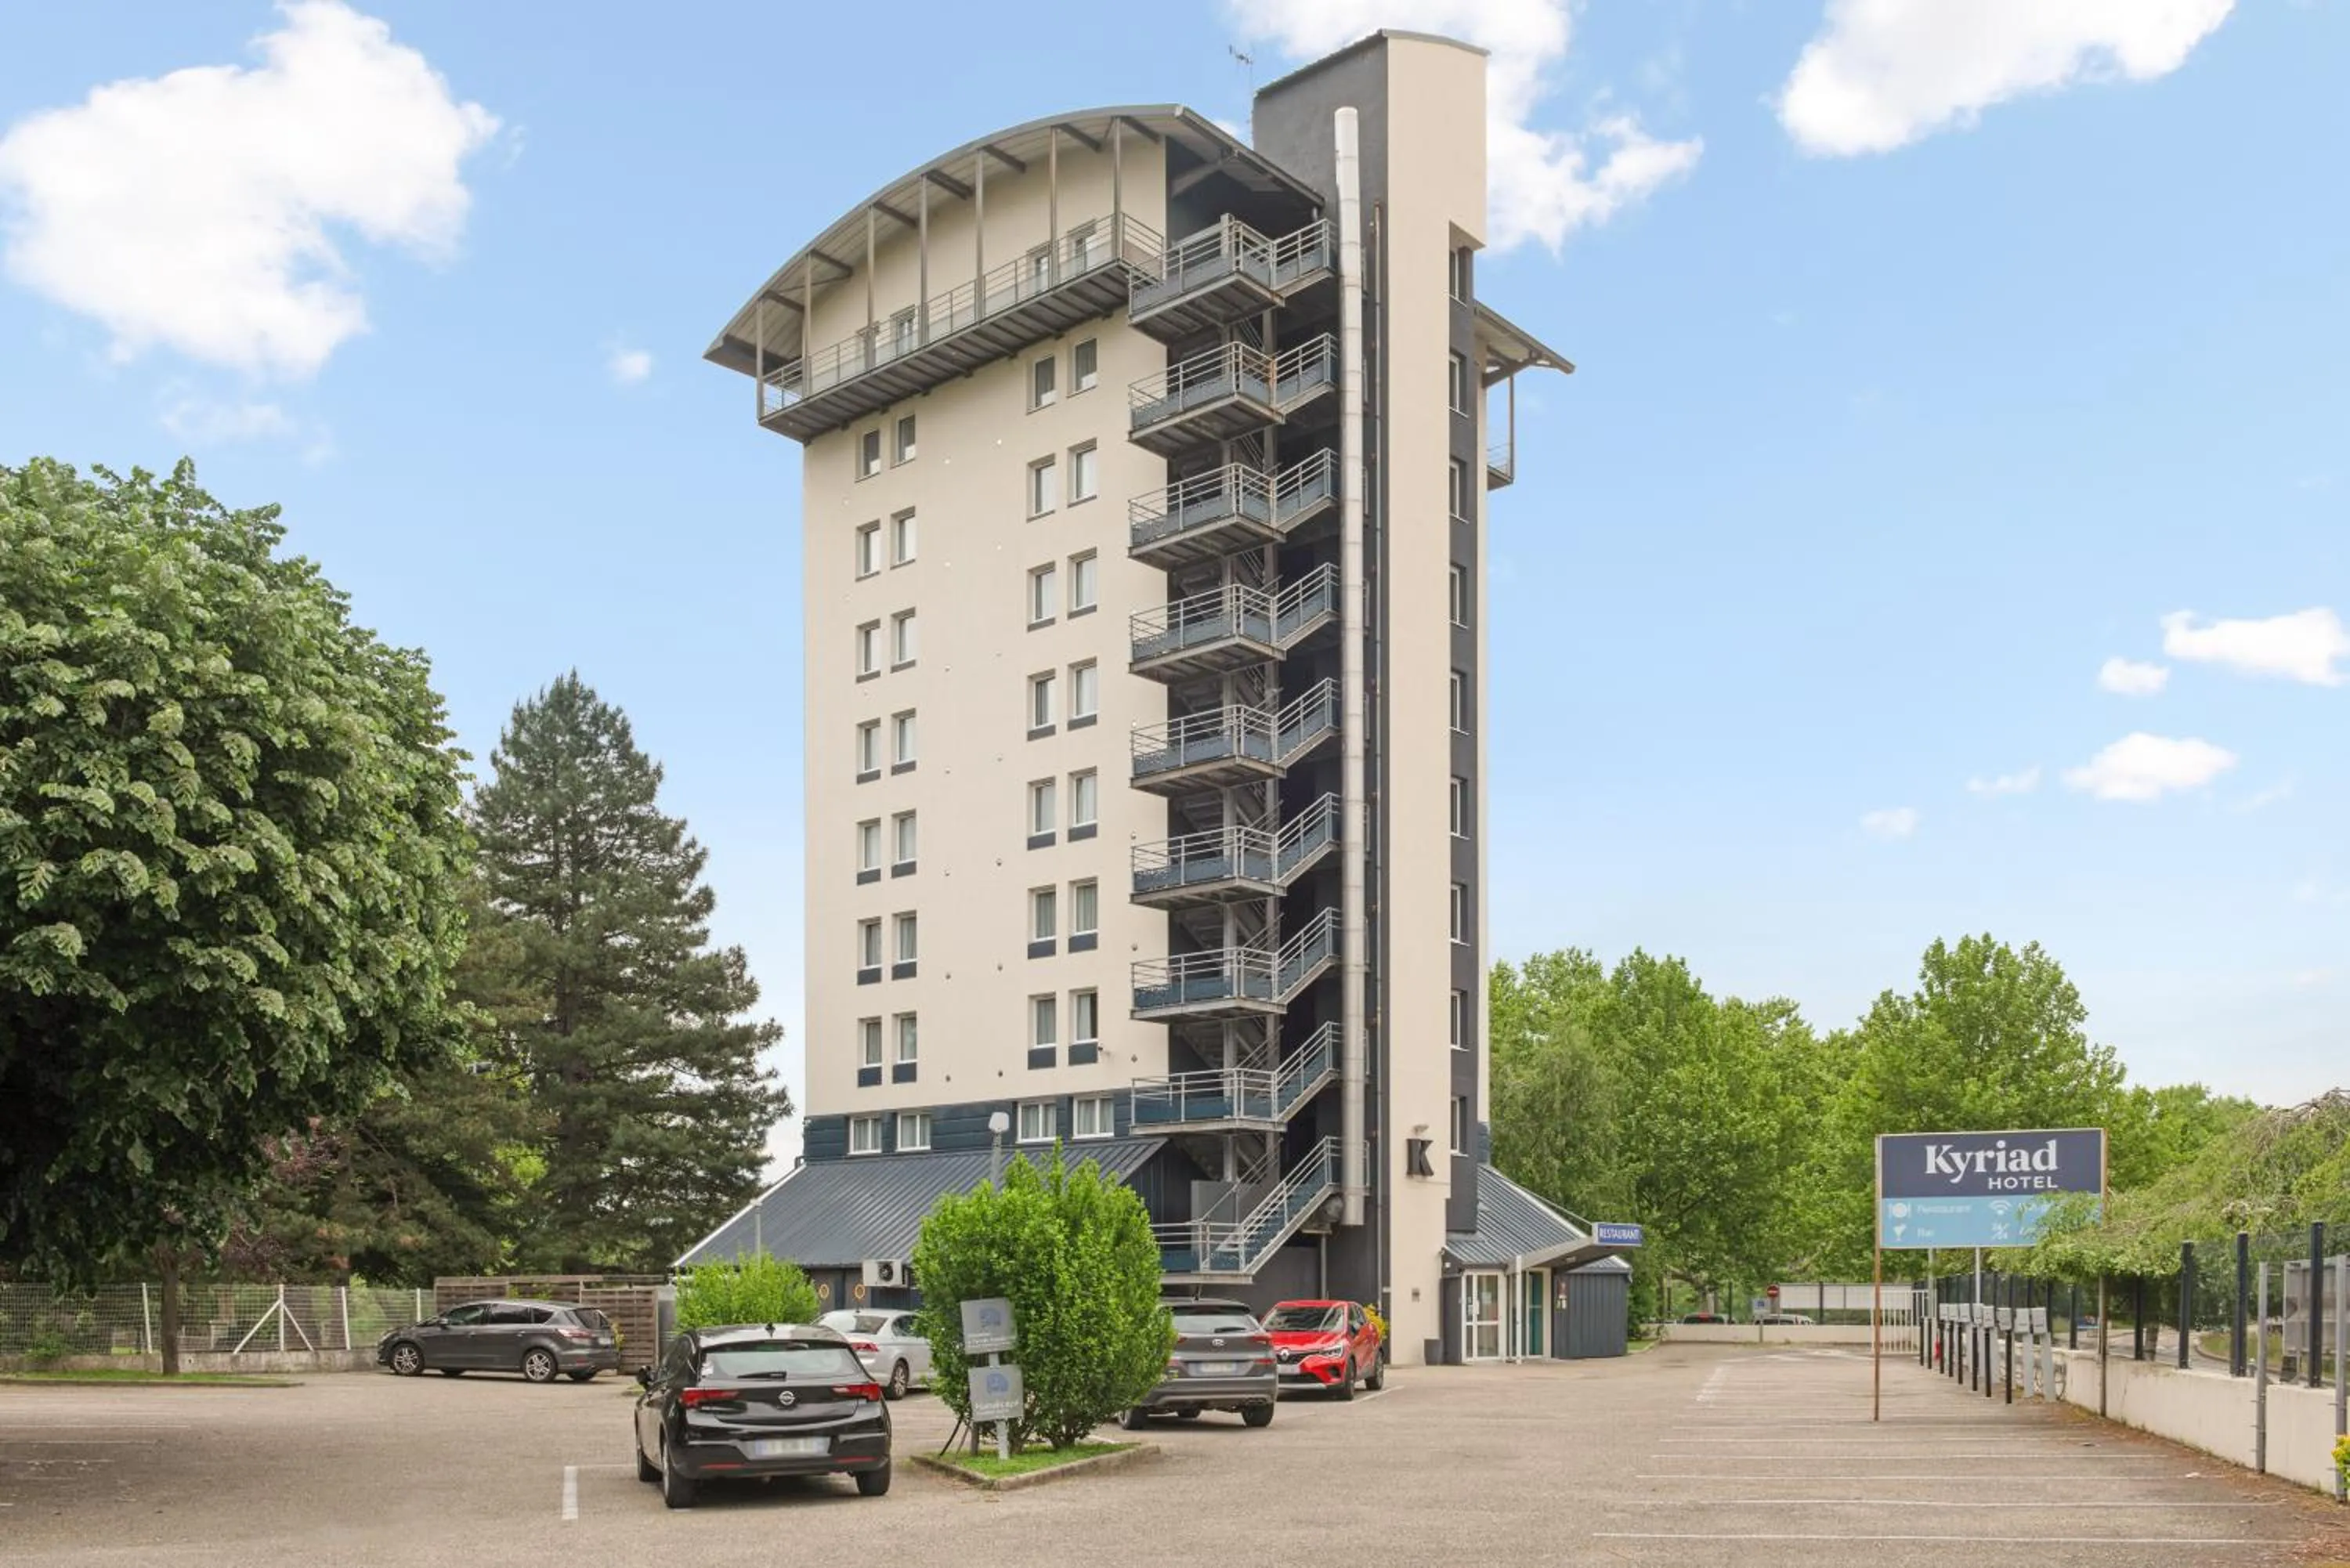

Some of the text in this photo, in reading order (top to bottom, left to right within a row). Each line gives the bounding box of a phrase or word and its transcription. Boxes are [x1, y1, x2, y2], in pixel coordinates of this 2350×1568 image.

[1406, 1138, 1434, 1176] K
[1925, 1140, 2059, 1183] Kyriad
[1988, 1176, 2059, 1190] HOTEL
